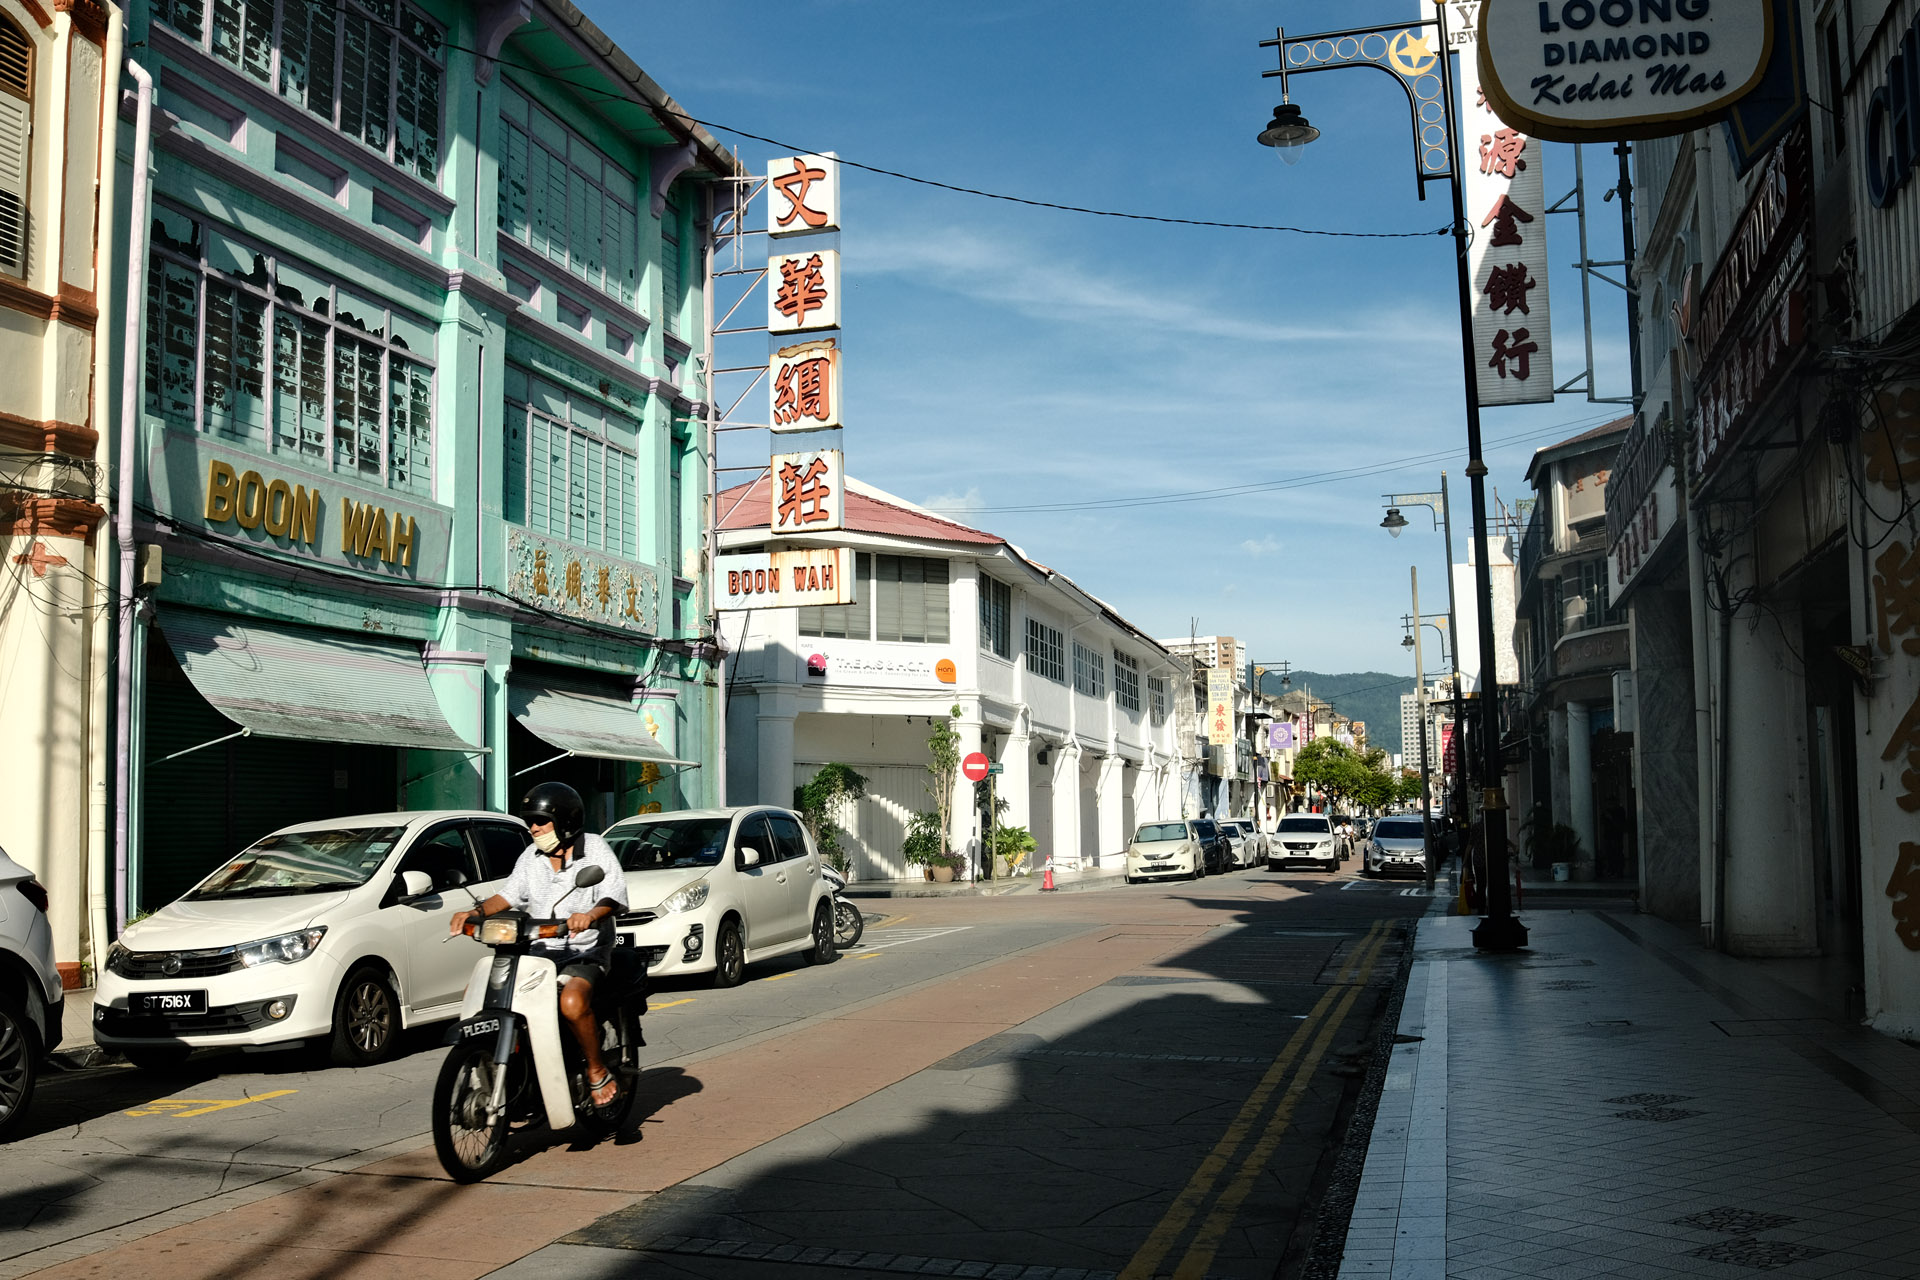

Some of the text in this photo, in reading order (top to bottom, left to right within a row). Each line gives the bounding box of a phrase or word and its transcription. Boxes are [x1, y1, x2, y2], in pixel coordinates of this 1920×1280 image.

[1538, 0, 1710, 33] LOONG
[1544, 31, 1710, 66] DIAMOND
[1531, 64, 1726, 105] Kedai Mas
[1742, 156, 1788, 289] TOURS
[204, 459, 415, 567] BOON WAH
[728, 564, 834, 596] BOON WAH
[143, 996, 157, 1009] ST
